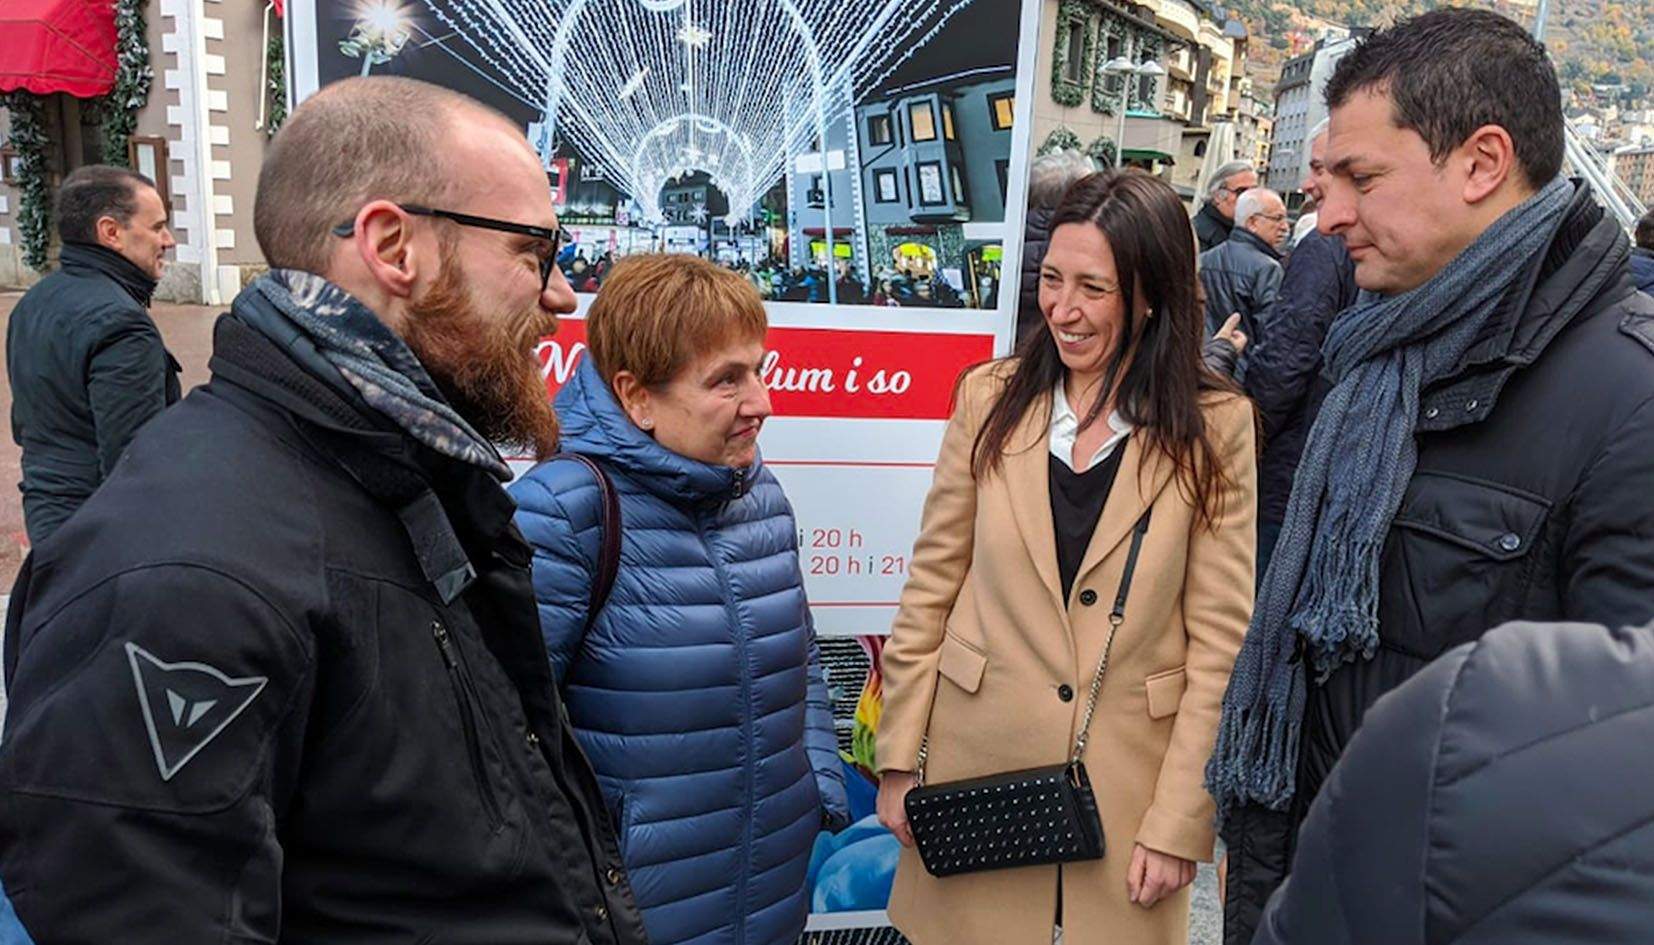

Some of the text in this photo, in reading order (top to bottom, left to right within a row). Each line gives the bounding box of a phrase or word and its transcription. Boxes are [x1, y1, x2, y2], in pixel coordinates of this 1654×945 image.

[532, 340, 912, 394] N lum i so
[798, 528, 863, 548] i 20 h
[810, 555, 905, 575] 20 h i 21
